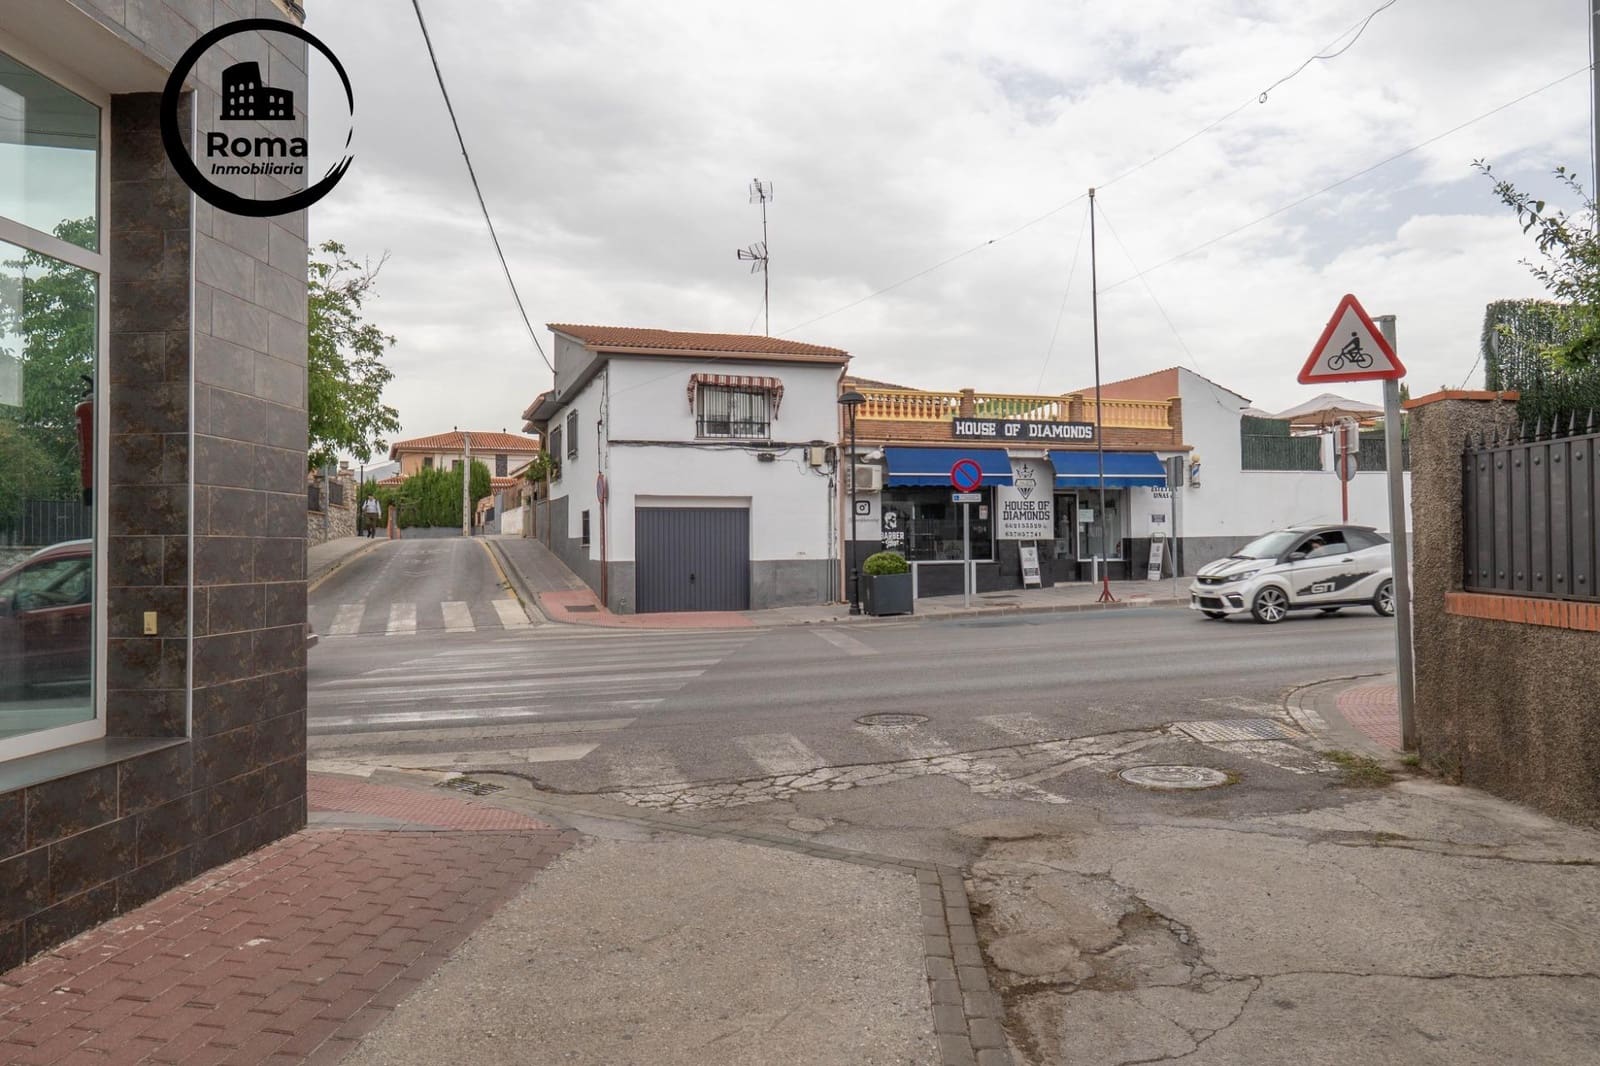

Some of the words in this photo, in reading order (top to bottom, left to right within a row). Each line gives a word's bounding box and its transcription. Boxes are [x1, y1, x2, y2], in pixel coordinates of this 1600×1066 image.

[955, 421, 996, 436] HOUSE
[1004, 423, 1021, 436] OF
[1029, 424, 1093, 439] DIAMONDS
[1004, 501, 1035, 511] HOUSE
[1037, 501, 1050, 511] OF
[1003, 511, 1050, 521] DIAMONDS
[880, 531, 904, 540] BARBER
